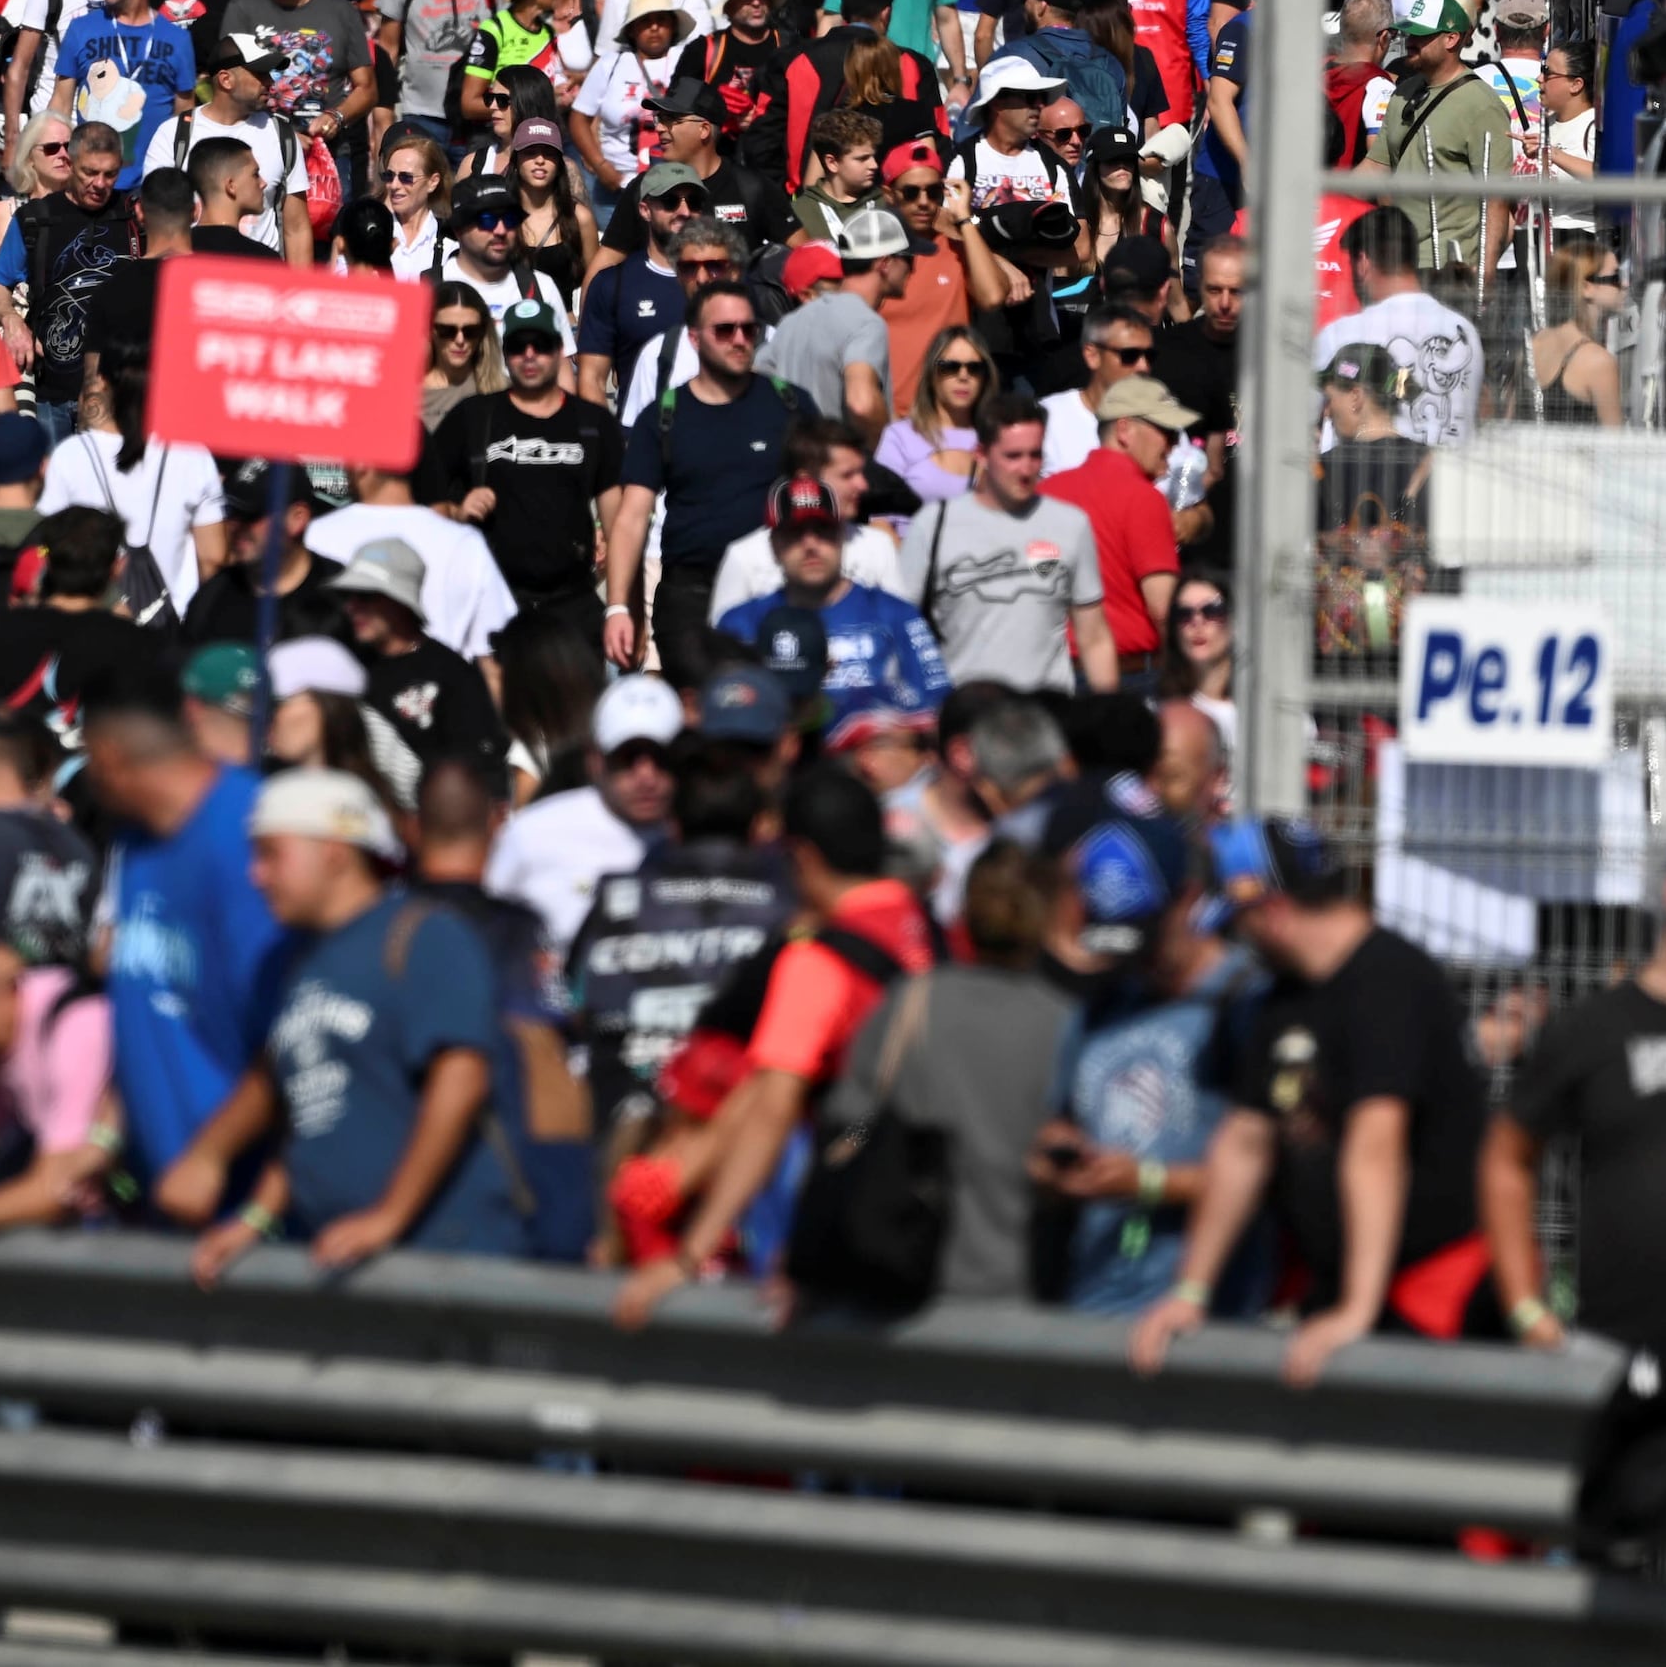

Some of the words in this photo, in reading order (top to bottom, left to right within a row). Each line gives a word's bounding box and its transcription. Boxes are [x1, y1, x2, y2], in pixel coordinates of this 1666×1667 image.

[84, 36, 141, 61] SHUT
[150, 37, 175, 61] UP
[196, 332, 269, 379] PIT
[272, 340, 382, 389] LANE
[222, 381, 347, 429] WALK
[1417, 631, 1601, 725] Pe.12
